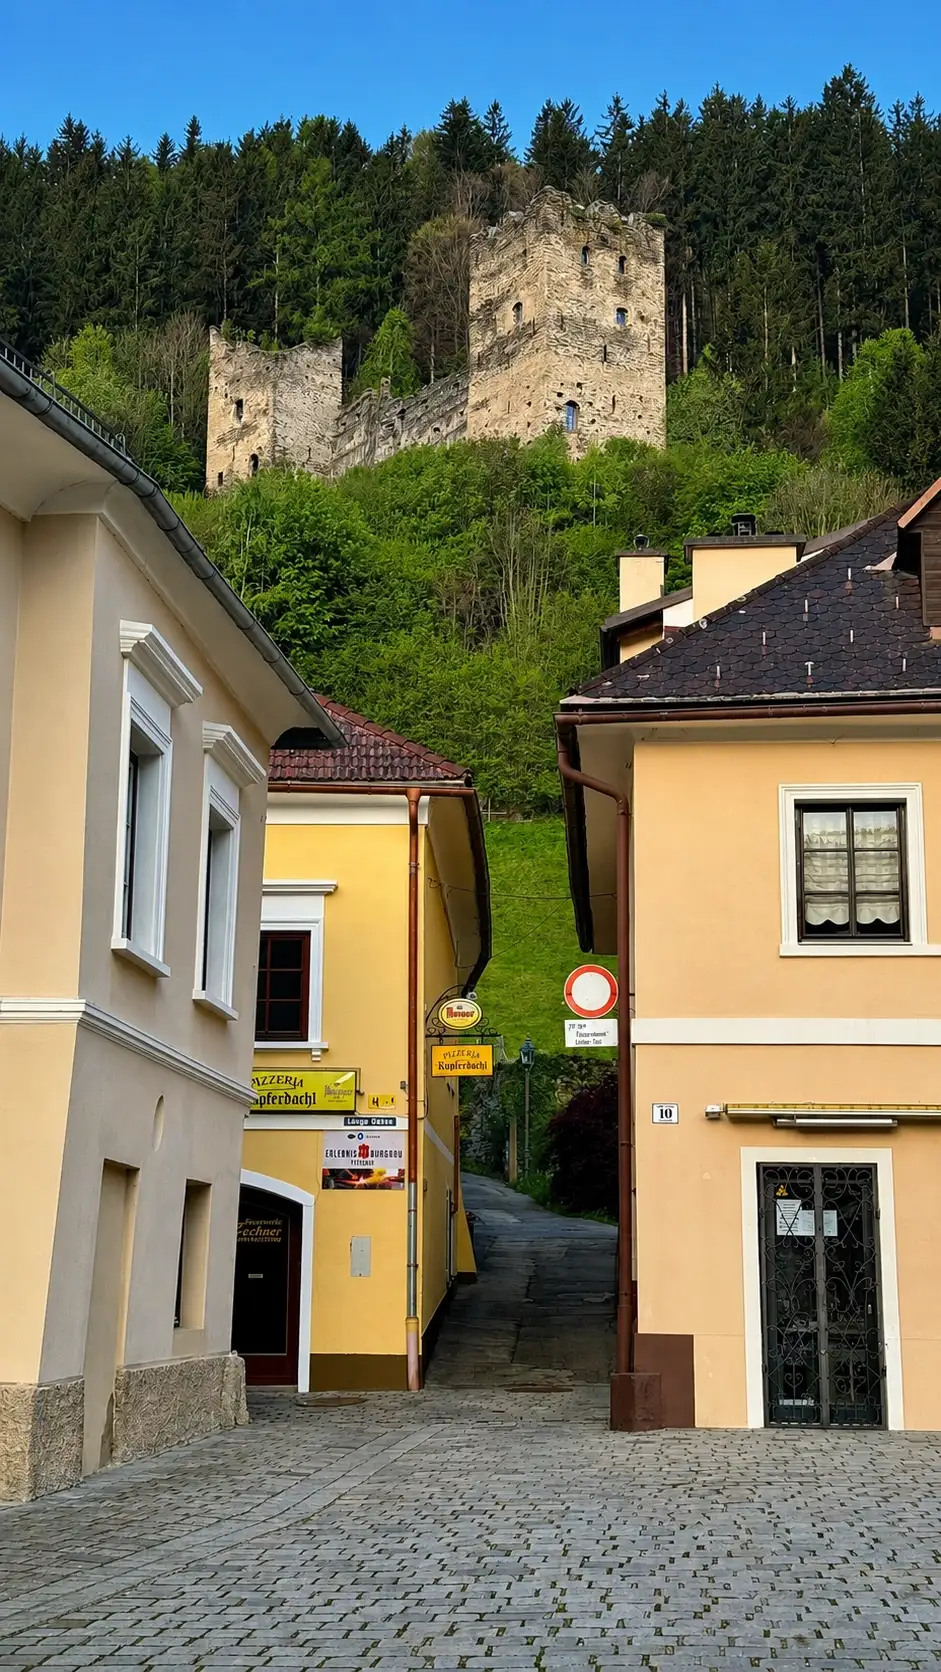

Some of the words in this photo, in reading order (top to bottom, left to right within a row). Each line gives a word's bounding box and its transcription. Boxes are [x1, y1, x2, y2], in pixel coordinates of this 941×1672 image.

[442, 1049, 480, 1060] PIZZERIA
[253, 1091, 317, 1108] pferdachl
[659, 1108, 673, 1119] 10
